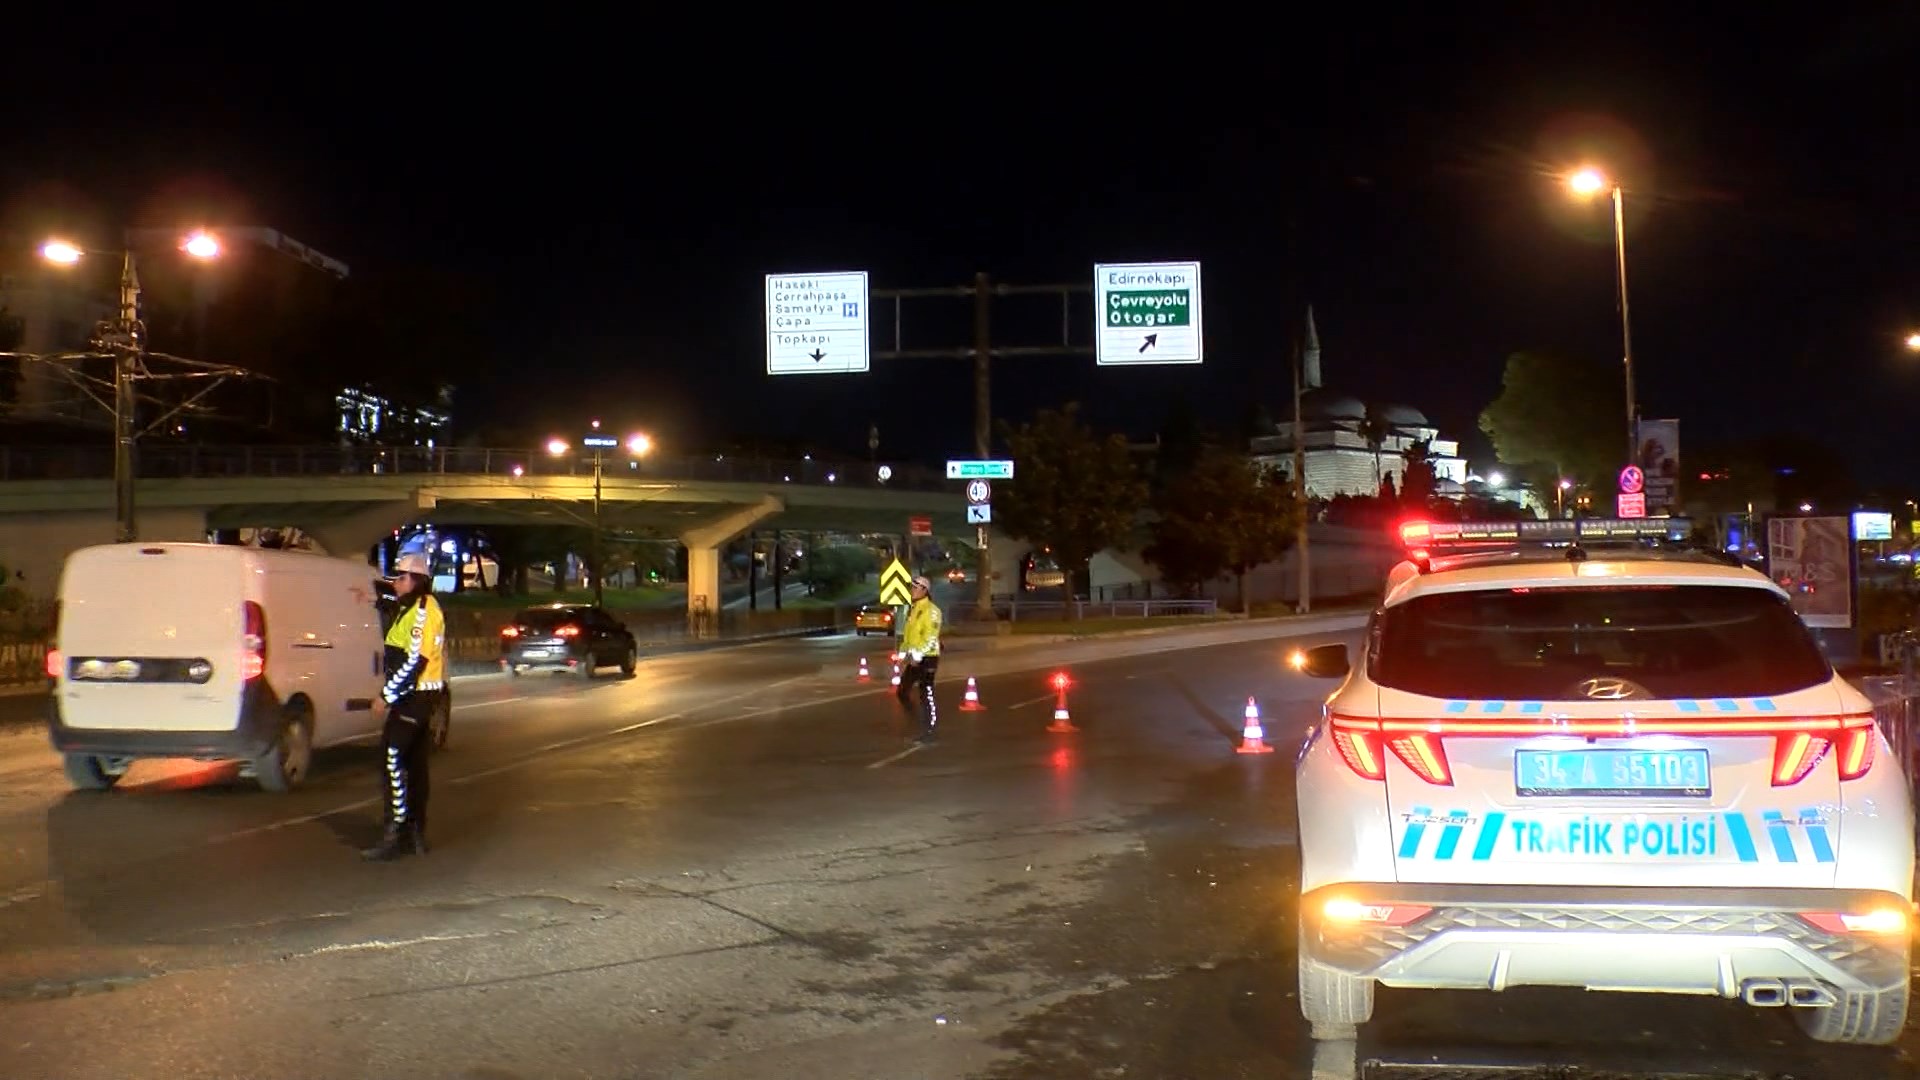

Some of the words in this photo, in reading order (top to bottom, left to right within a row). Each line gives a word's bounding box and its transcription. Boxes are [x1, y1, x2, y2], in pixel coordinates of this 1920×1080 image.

[1109, 272, 1185, 287] Edirnekapı
[1110, 292, 1187, 309] Çevreyolu
[1110, 311, 1176, 326] Otogar
[776, 334, 830, 346] Topkapı
[1533, 755, 1567, 785] 34
[1582, 755, 1598, 785] A
[1511, 816, 1613, 854] TRAFİK
[1623, 816, 1716, 855] POLİSİ
